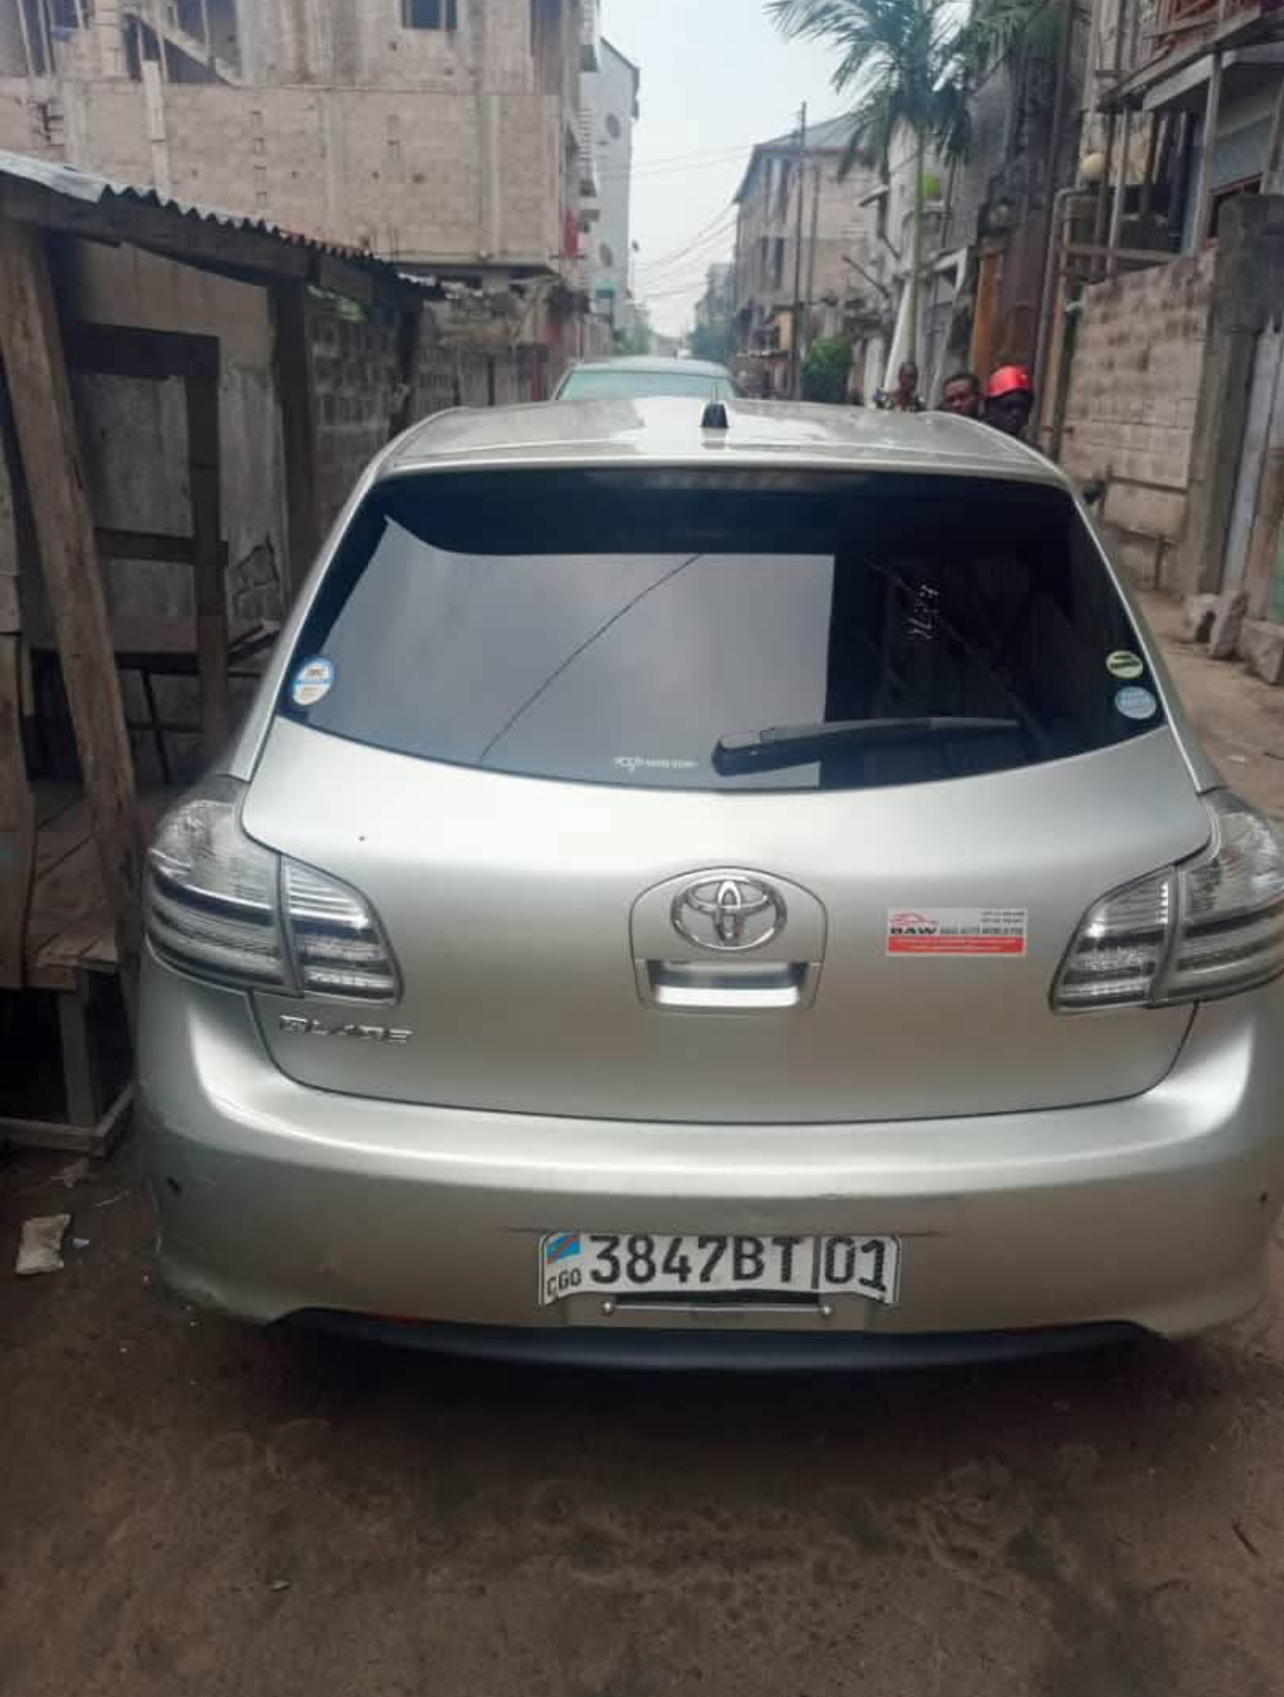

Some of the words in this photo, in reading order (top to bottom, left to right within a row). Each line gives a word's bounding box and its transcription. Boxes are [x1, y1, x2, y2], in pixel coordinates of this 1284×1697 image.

[546, 1268, 582, 1298] CGO
[589, 1235, 804, 1284] 3847BT
[824, 1236, 887, 1292] 01
